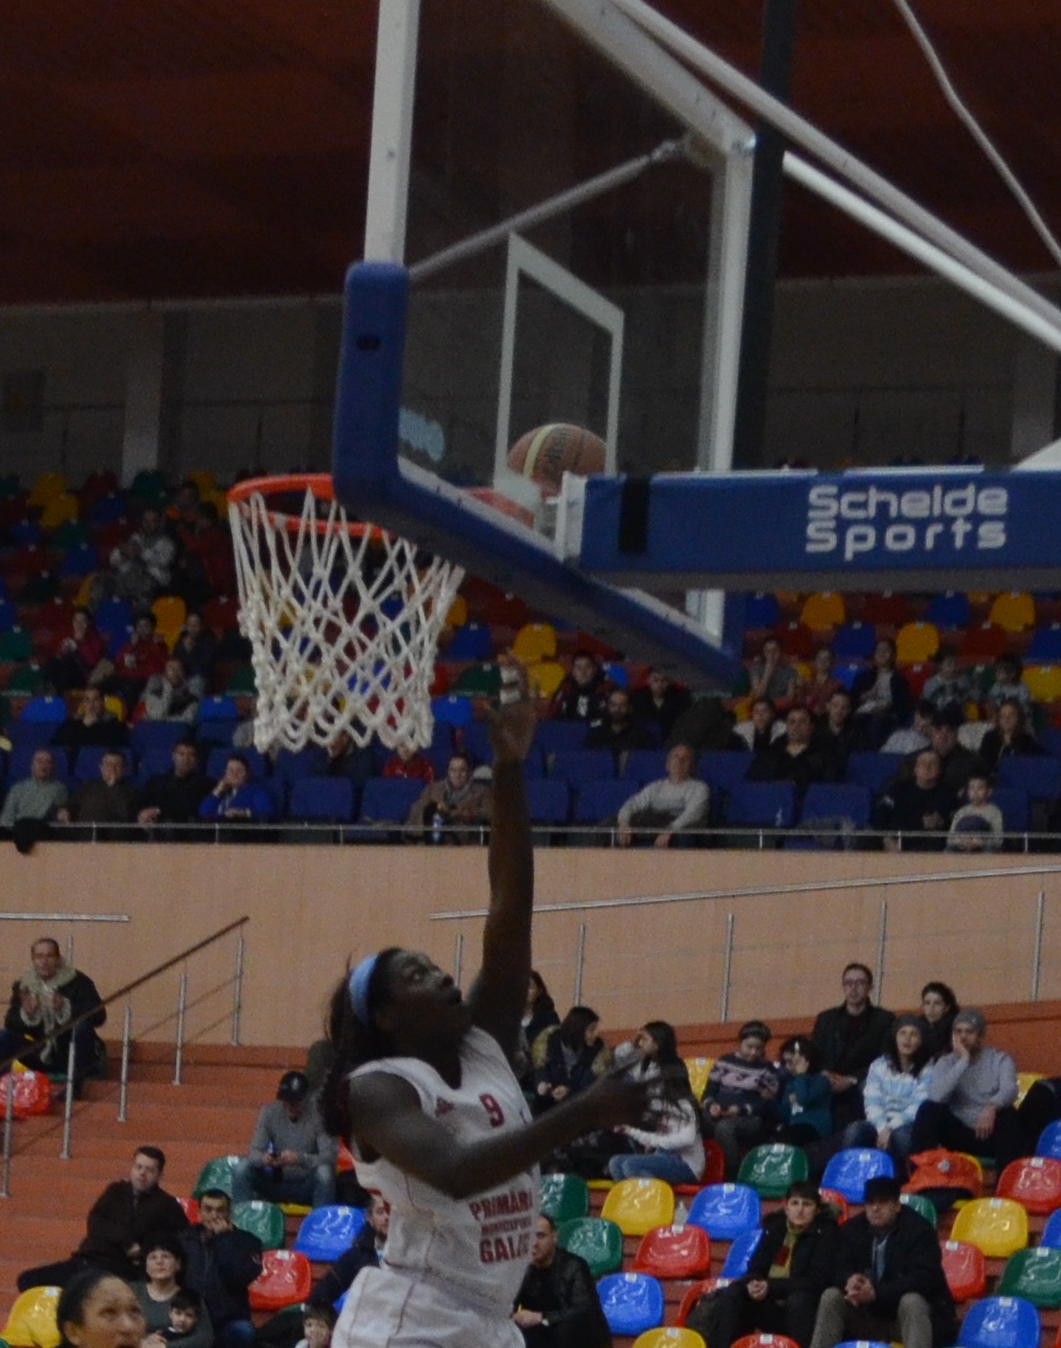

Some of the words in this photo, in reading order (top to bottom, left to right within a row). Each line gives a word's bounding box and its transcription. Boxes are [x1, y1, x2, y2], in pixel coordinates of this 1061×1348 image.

[808, 482, 1008, 520] Schelde
[805, 517, 1007, 561] Sports
[479, 1093, 505, 1127] 9
